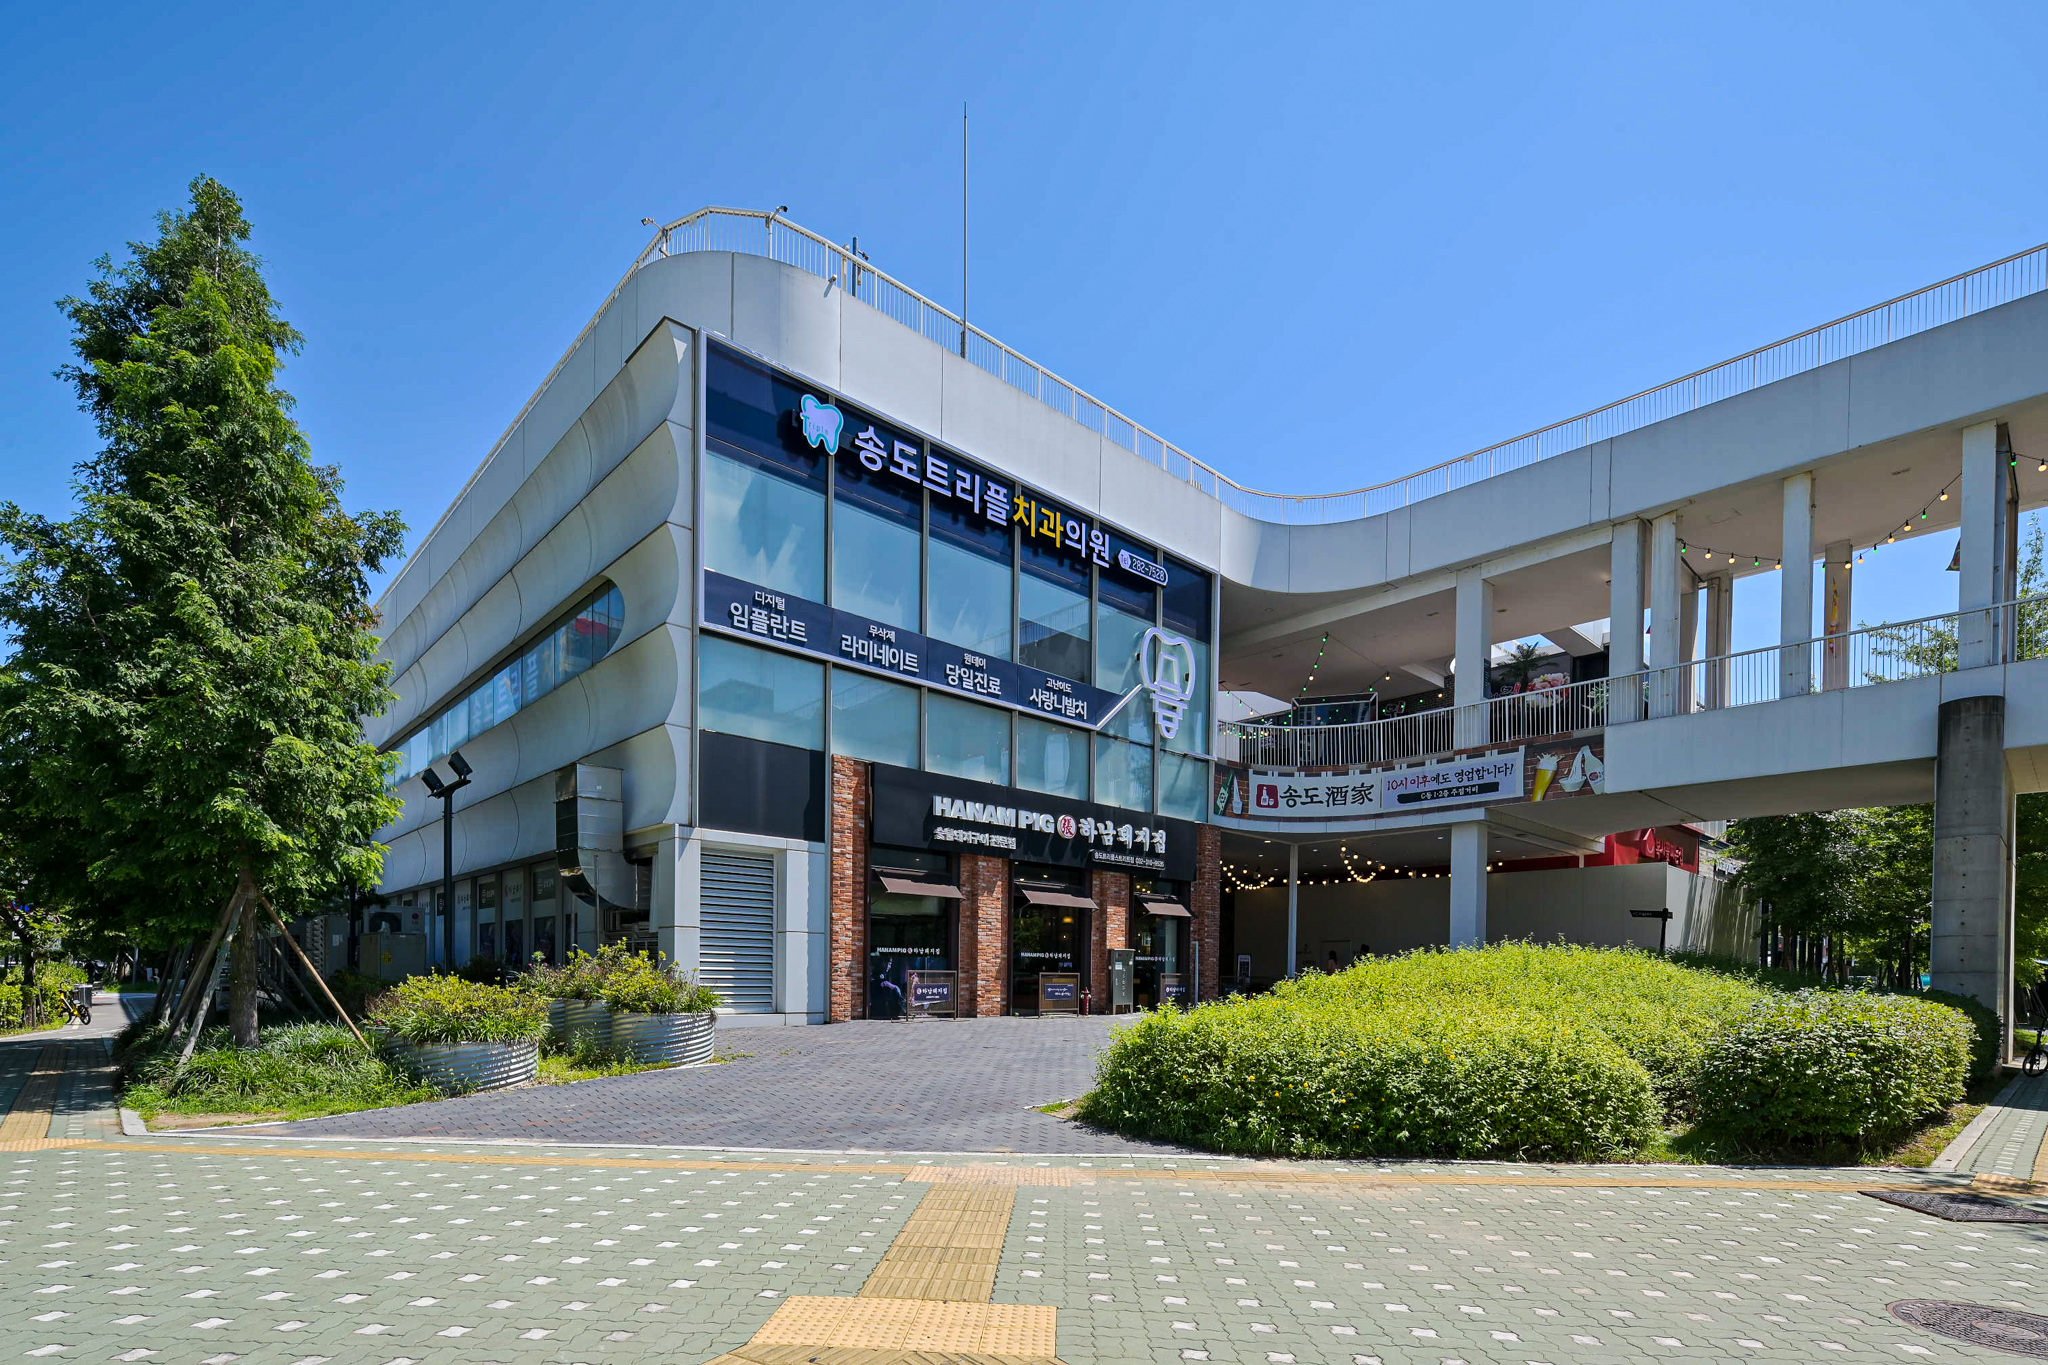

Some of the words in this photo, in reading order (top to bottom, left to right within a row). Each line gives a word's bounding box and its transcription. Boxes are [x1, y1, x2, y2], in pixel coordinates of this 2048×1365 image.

[854, 425, 1110, 569] 송도트리플치과의원
[1132, 558, 1165, 581] 282-7528
[755, 590, 786, 611] 디지털
[730, 602, 808, 642] 임플란트
[869, 624, 896, 643] 무삭제
[841, 634, 919, 673] 라미네이트
[964, 653, 987, 669] 원데이
[946, 663, 1002, 695] 당일진료
[1046, 677, 1072, 693] 고난이도
[1029, 688, 1087, 720] 사랑니발치
[1387, 776, 1408, 791] 10시
[1410, 773, 1452, 789] 이후에도
[1454, 763, 1515, 783] 영업합니다!
[932, 795, 1016, 828] HANAM
[1017, 809, 1055, 834] PIG
[1078, 817, 1166, 854] 하남돼지집
